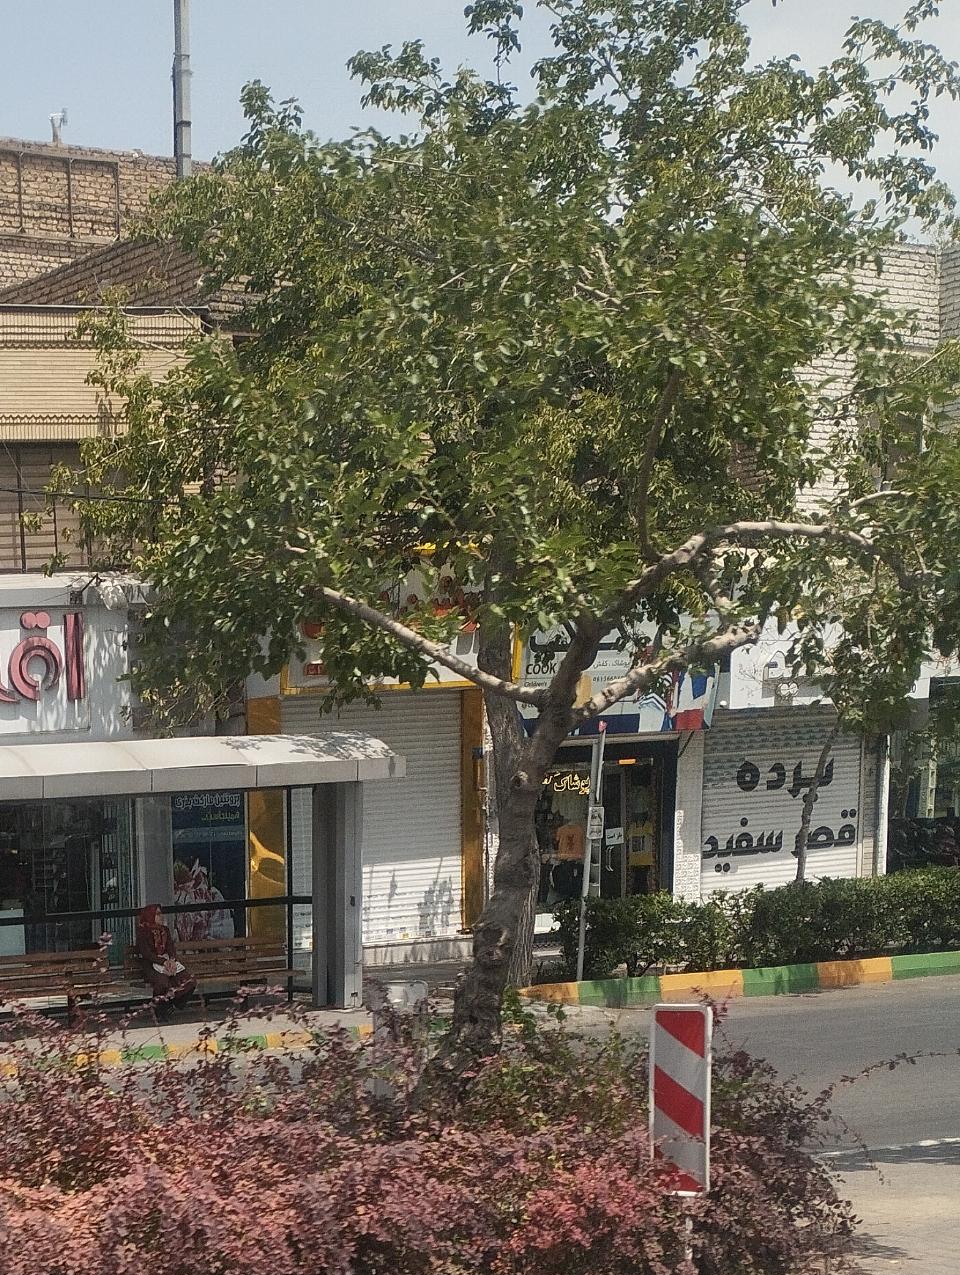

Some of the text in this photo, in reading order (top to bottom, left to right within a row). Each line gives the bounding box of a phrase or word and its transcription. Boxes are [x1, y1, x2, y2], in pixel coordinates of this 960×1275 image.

[525, 662, 556, 675] COOK
[736, 757, 835, 803] پرده
[701, 816, 784, 873] سفید
